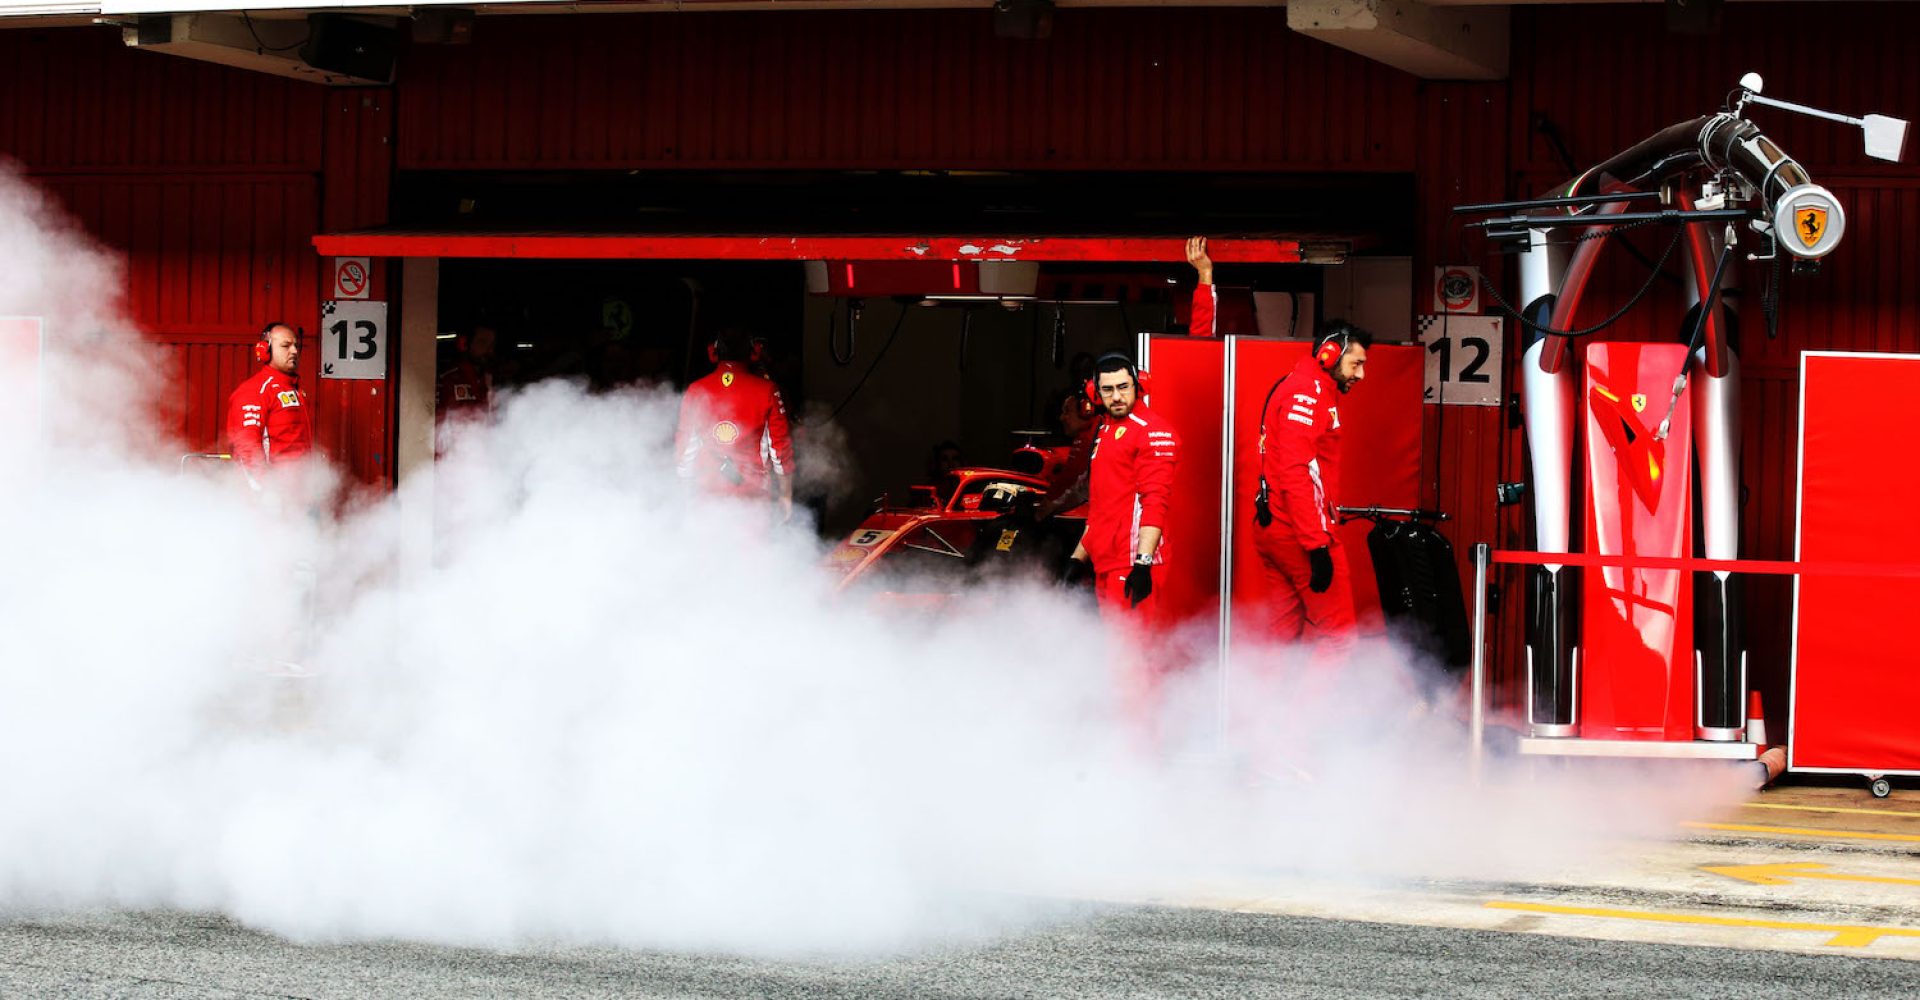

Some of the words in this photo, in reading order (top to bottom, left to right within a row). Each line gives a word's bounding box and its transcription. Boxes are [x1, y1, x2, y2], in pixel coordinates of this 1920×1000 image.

[330, 320, 377, 360] 13
[1428, 337, 1490, 383] 12
[857, 531, 881, 544] 5
